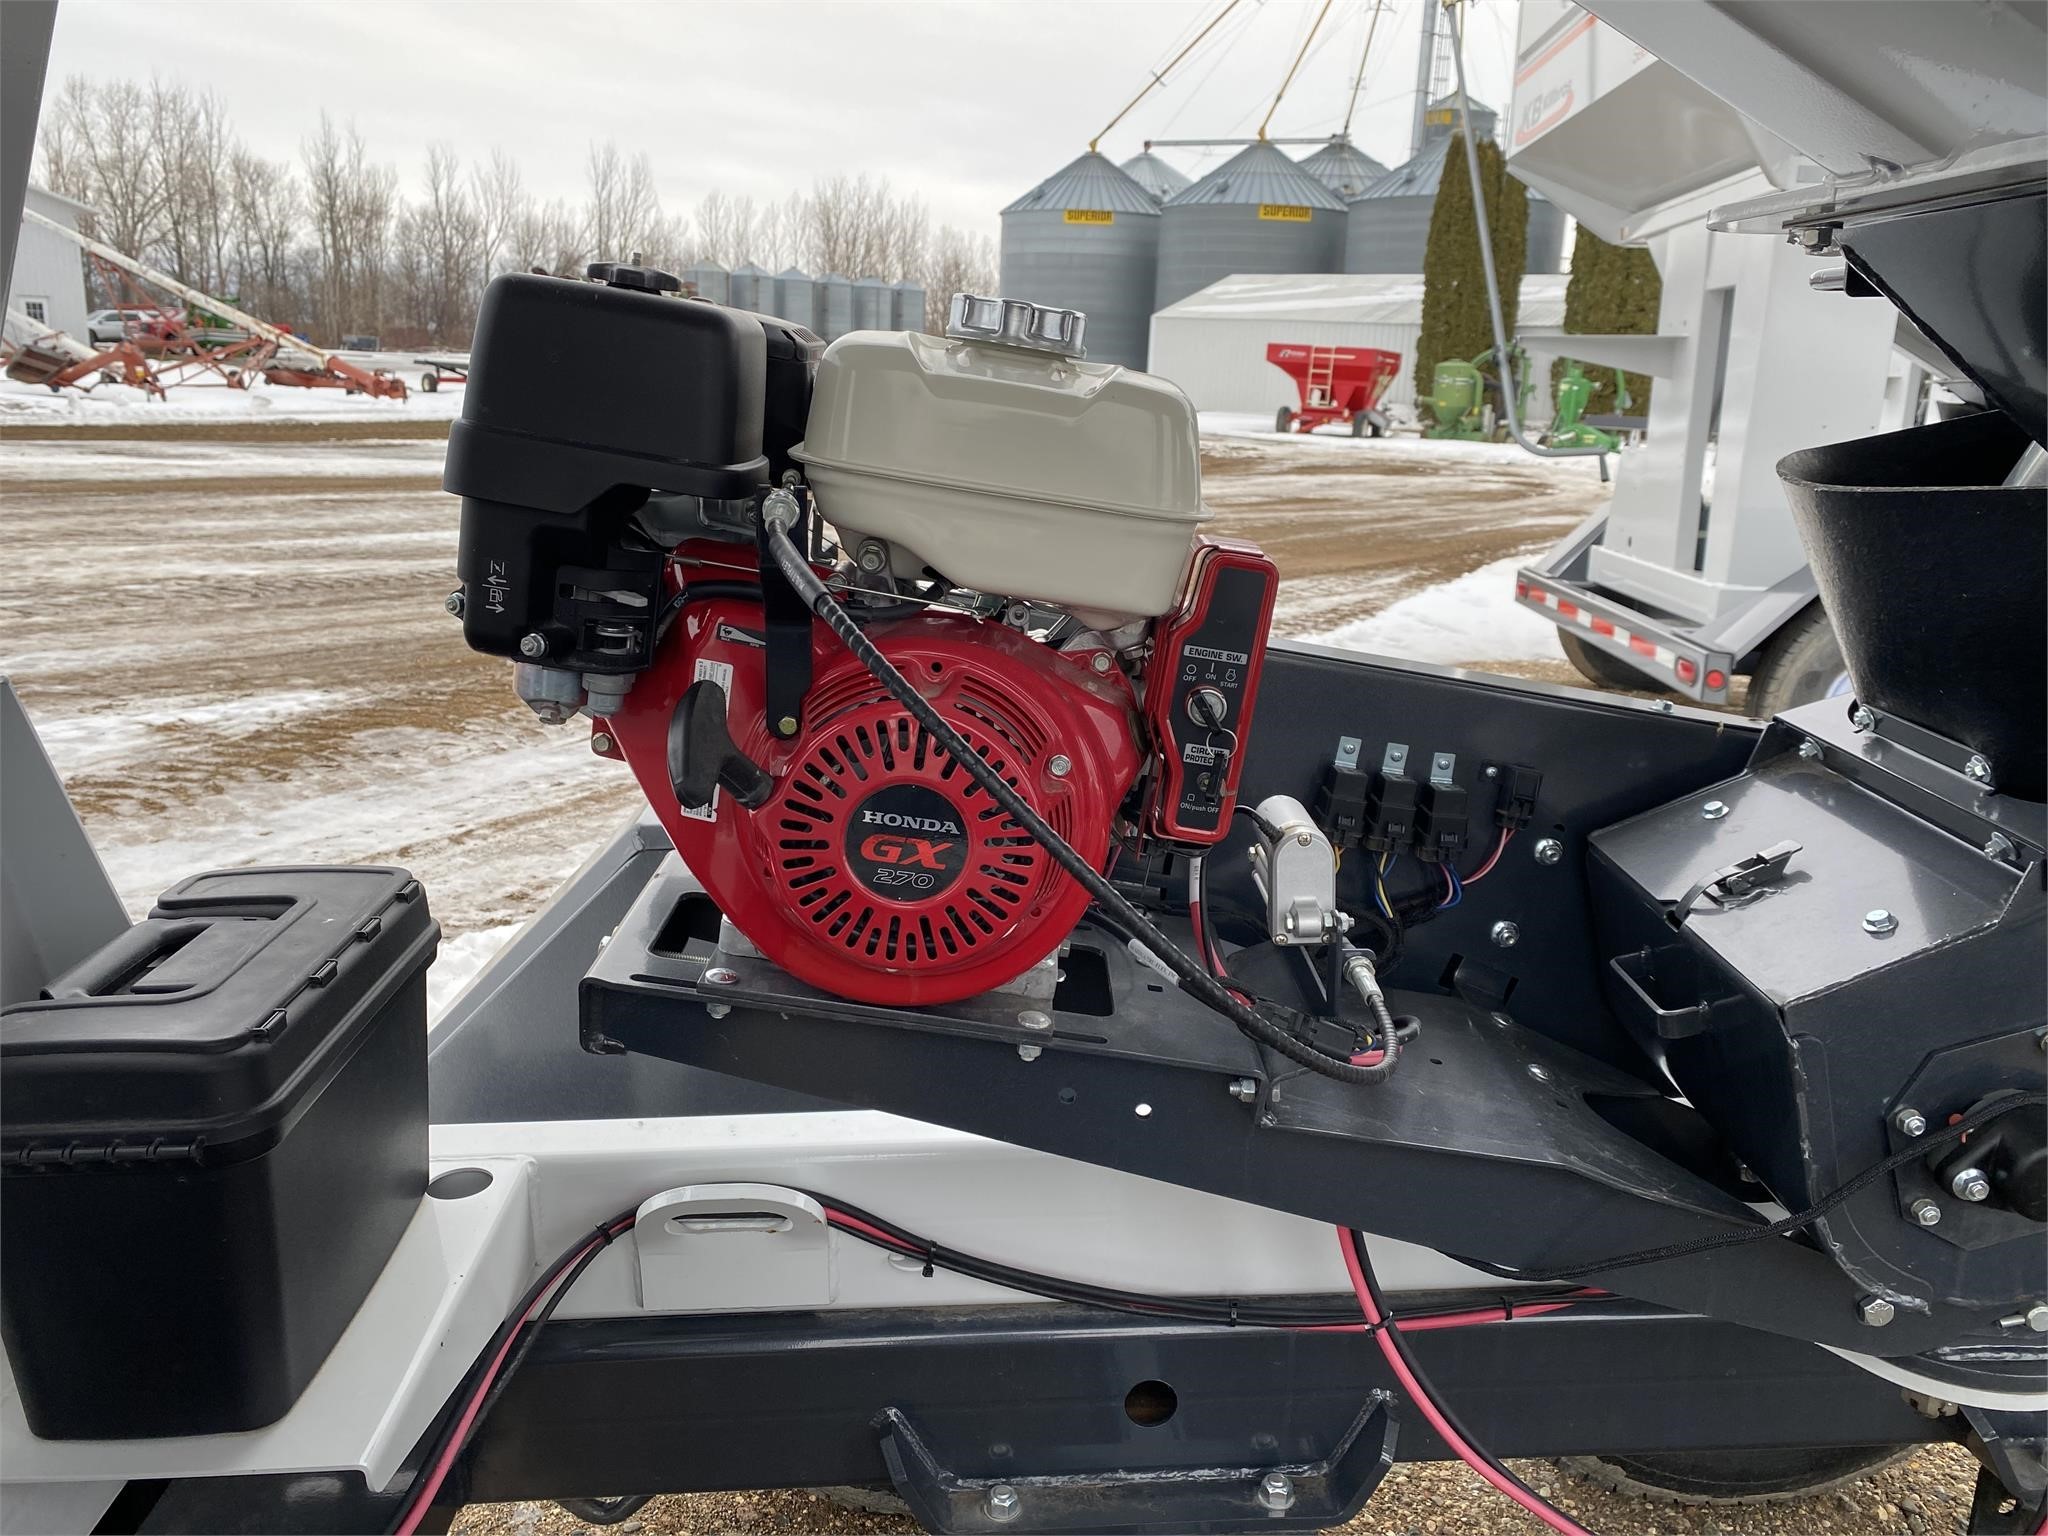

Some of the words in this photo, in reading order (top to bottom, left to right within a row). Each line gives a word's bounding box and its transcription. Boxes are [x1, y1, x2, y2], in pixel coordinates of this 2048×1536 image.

[1066, 209, 1113, 222] SUPERIOR
[1262, 204, 1311, 218] SUPERIOR
[1188, 647, 1224, 660] ENGINE
[1225, 653, 1243, 663] SW.
[1182, 674, 1197, 682] OFF
[1205, 672, 1217, 681] ON
[1219, 681, 1238, 689] START
[1185, 753, 1214, 764] PROTEC
[1180, 802, 1206, 812] ON/push
[1207, 806, 1220, 814] OFF
[862, 810, 960, 835] HONDA
[860, 833, 954, 870] GX
[873, 867, 934, 889] 270
